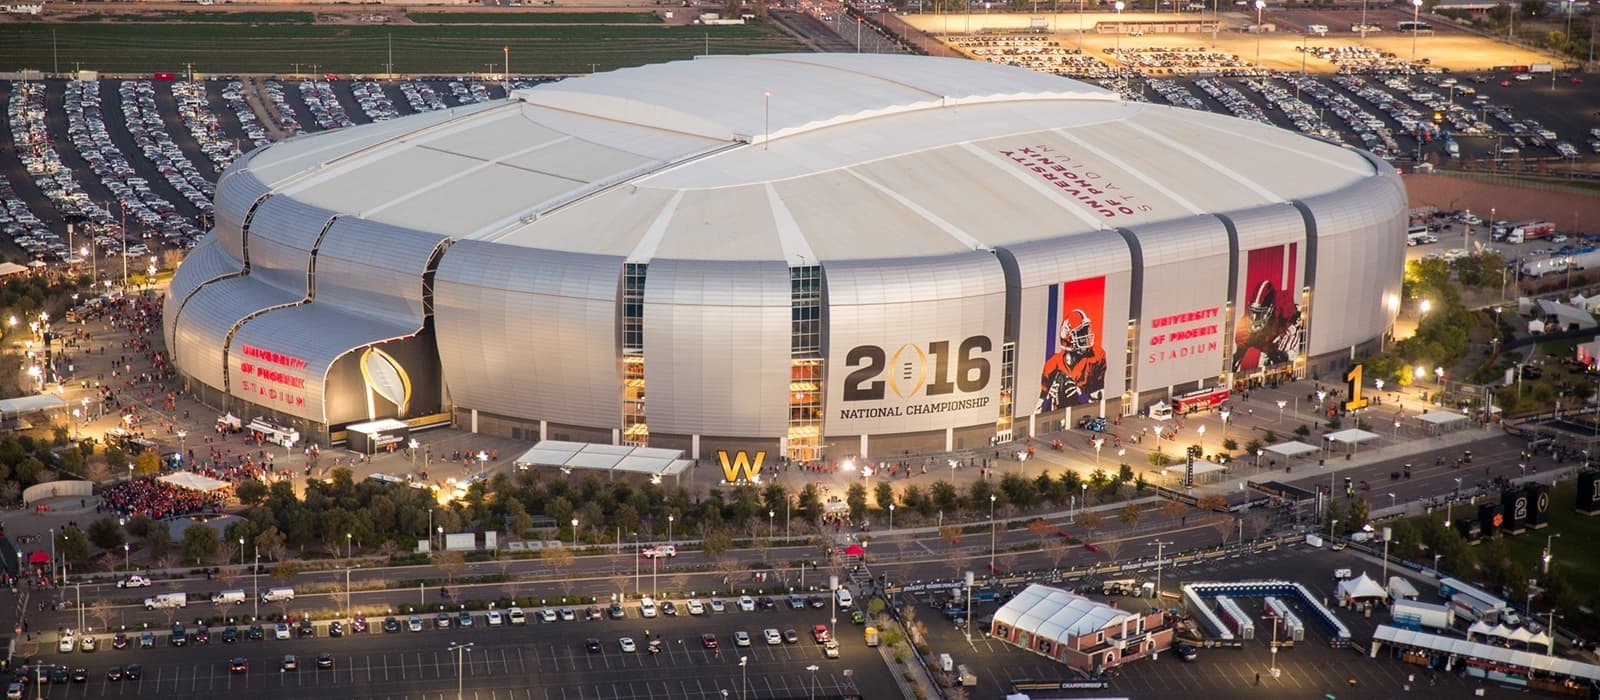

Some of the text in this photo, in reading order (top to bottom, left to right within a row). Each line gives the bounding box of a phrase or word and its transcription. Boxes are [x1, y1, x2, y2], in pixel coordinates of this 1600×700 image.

[1000, 150, 1115, 217] UNIVERSITY
[1018, 147, 1134, 215] OF PHOENIX
[1036, 144, 1153, 212] STADIUM
[1151, 307, 1219, 329] UNIVERSITY
[1150, 324, 1218, 346] OF PHOENIX
[242, 344, 307, 371] UNIVERSITY
[1148, 341, 1217, 364] STADIUM
[241, 362, 304, 389] OF PHOENIX
[1345, 363, 1368, 411] 1
[241, 380, 305, 408] STADIUM
[840, 396, 990, 419] NATIONAL CHAMPIONSHIP
[717, 450, 766, 483] W
[1514, 497, 1527, 520] 2
